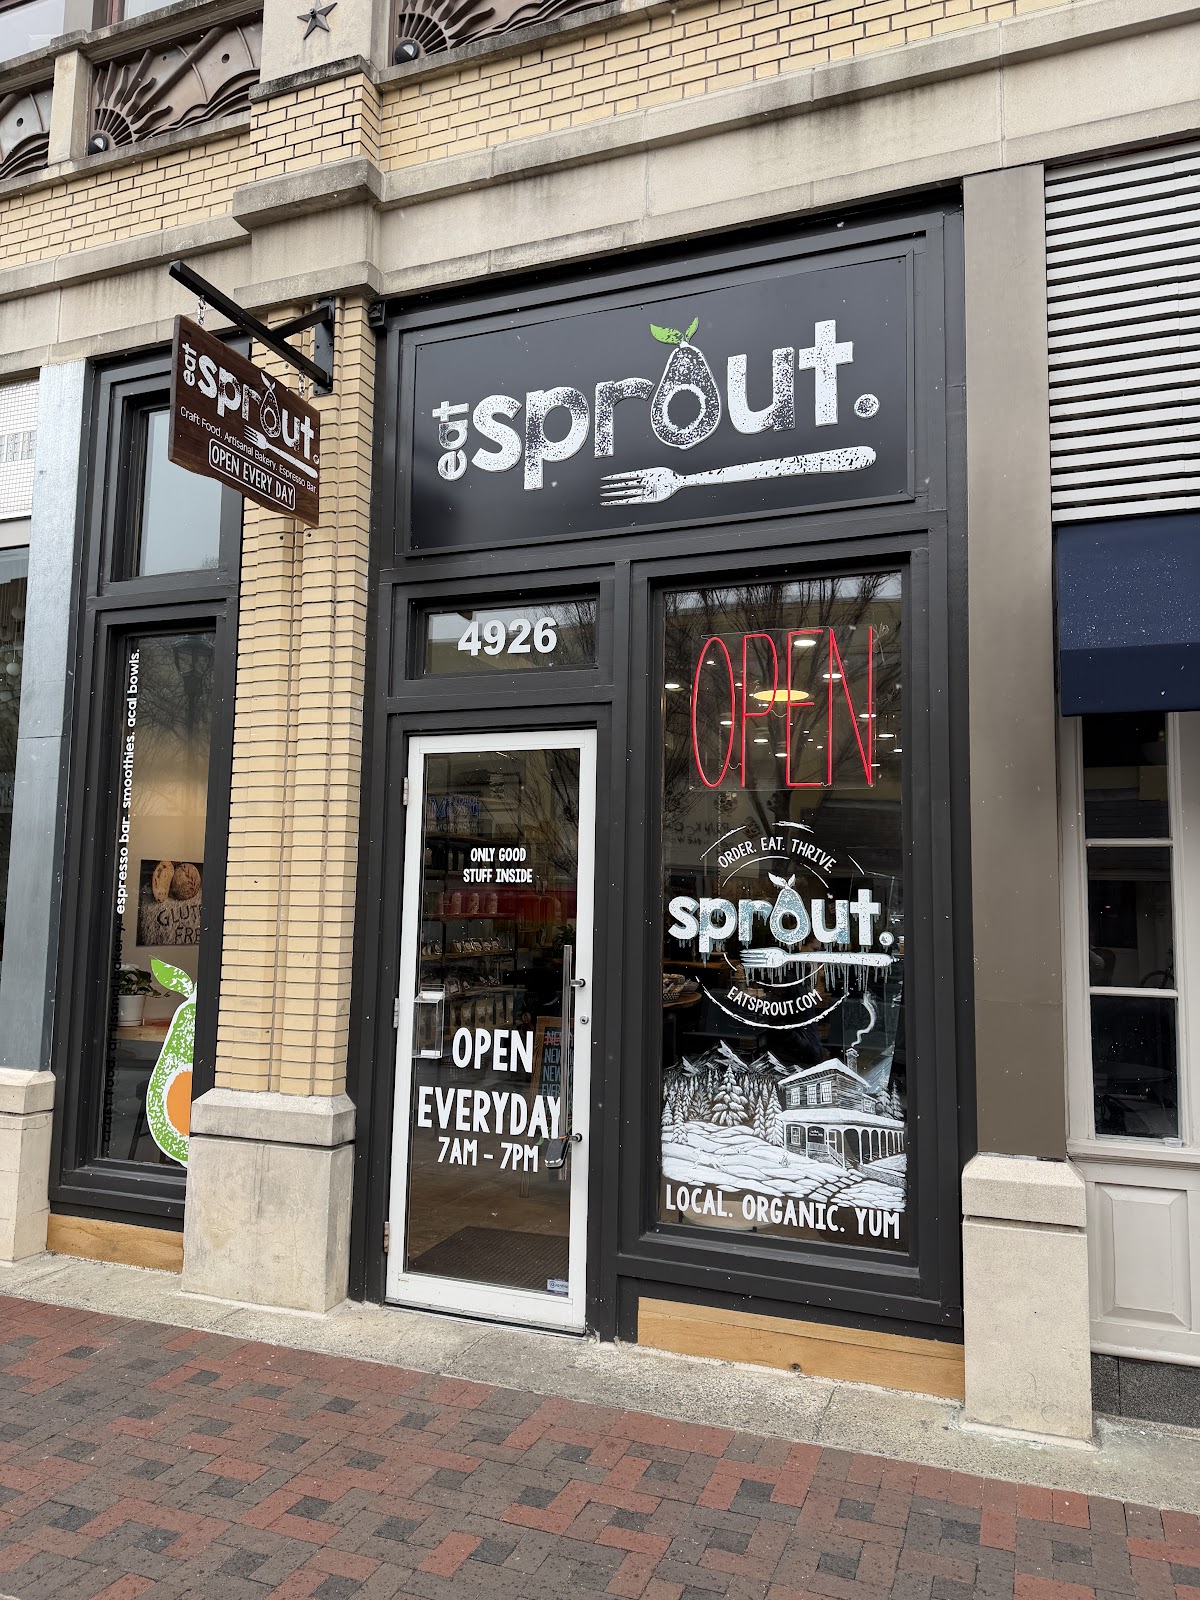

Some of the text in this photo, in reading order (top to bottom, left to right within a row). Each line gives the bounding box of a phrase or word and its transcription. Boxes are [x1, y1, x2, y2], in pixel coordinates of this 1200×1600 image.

[182, 342, 197, 387] eat
[180, 406, 318, 495] Craft Food. Artisanal Bakery. Espresso Bar.
[432, 400, 470, 481] eat
[212, 446, 294, 505] OPEN EVERY DAY
[457, 617, 558, 656] 4926
[127, 648, 140, 694] bowls.
[691, 626, 873, 788] OPEN
[123, 731, 136, 809] smoothies.
[119, 814, 131, 843] bar.
[463, 868, 534, 883] STUFF INSIDE
[470, 847, 527, 862] ONLY GOOD
[718, 837, 838, 874] ORDER. EAT. THRIVE.
[116, 847, 130, 915] espresso
[726, 986, 823, 1017] EATSPROUT.COM
[452, 1027, 534, 1074] OPEN
[417, 1086, 561, 1140] EVERYDAY
[438, 1137, 478, 1167] 7AM
[500, 1142, 539, 1173] 7PM
[665, 1184, 901, 1240] LOCAL. ORGANIC. YUM
